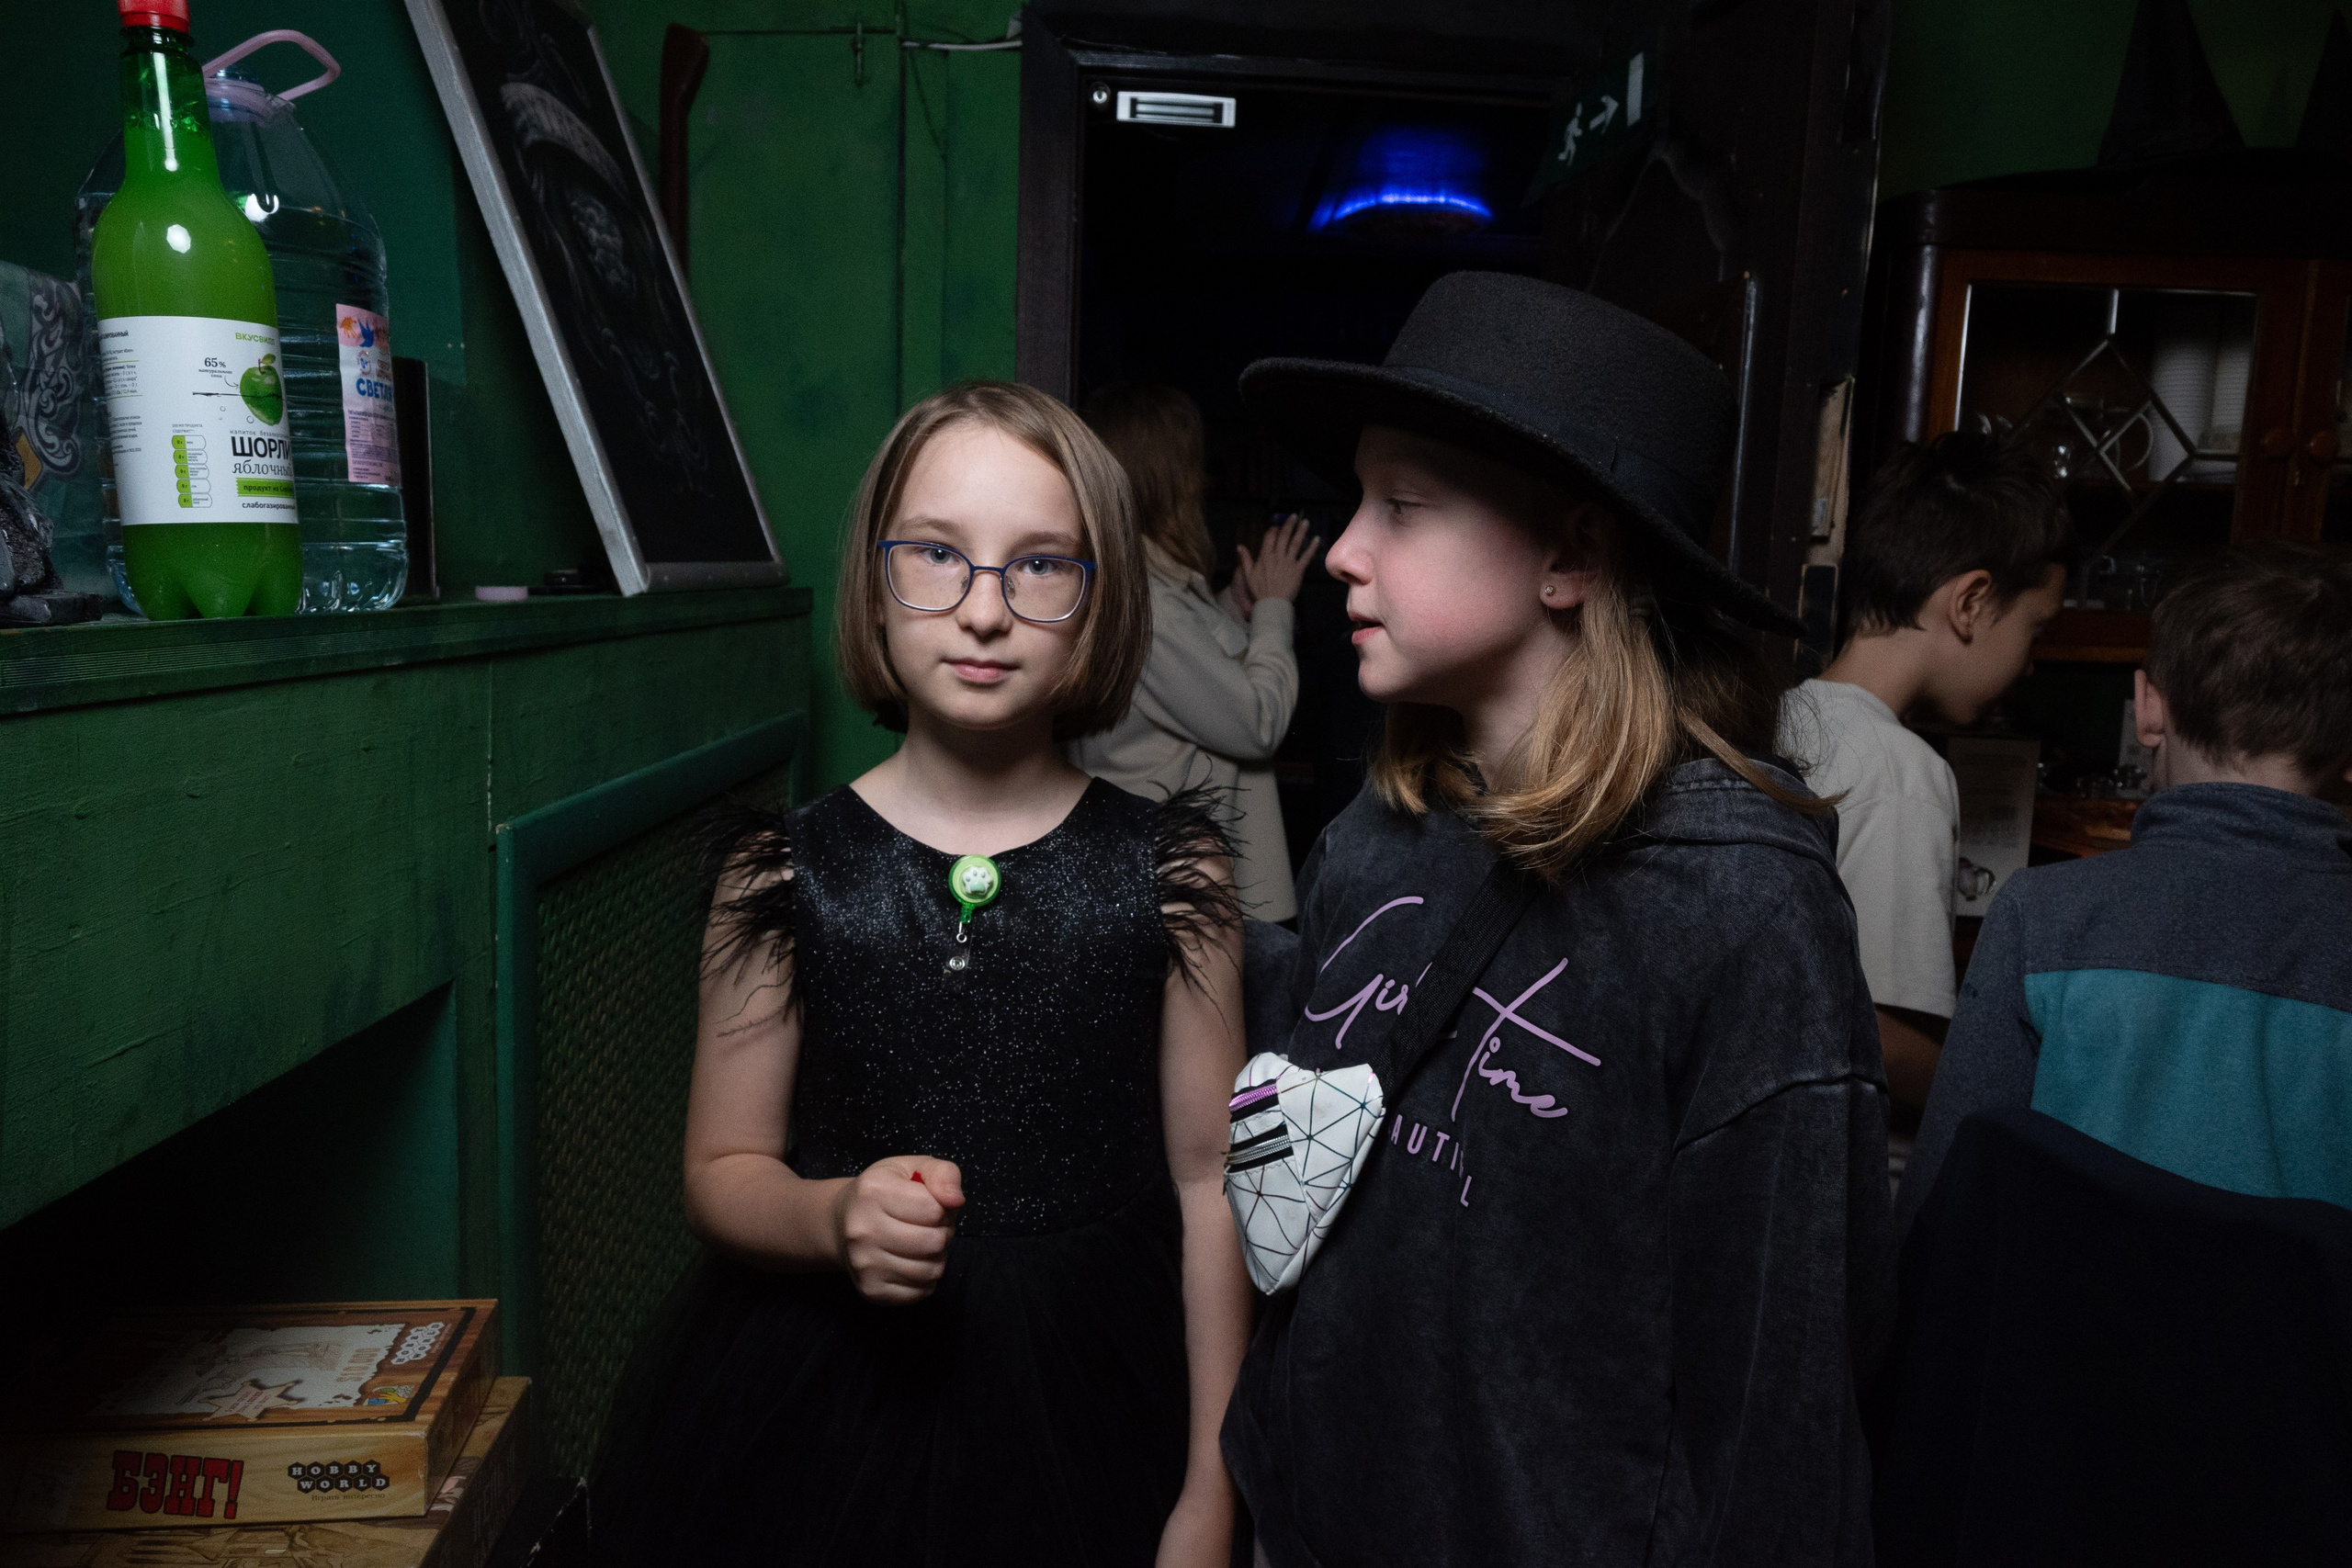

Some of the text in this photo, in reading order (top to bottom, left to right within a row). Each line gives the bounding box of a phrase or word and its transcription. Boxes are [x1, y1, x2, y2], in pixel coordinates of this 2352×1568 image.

[204, 357, 227, 368] 65%
[231, 435, 291, 460] ШОРЛИ
[232, 459, 293, 477] яблочный
[1452, 957, 1602, 1122] Time
[290, 1462, 378, 1477] HOBBY
[106, 1450, 244, 1519] БЭНГ!
[299, 1477, 387, 1490] WORLD
[343, 1493, 386, 1501] интересно
